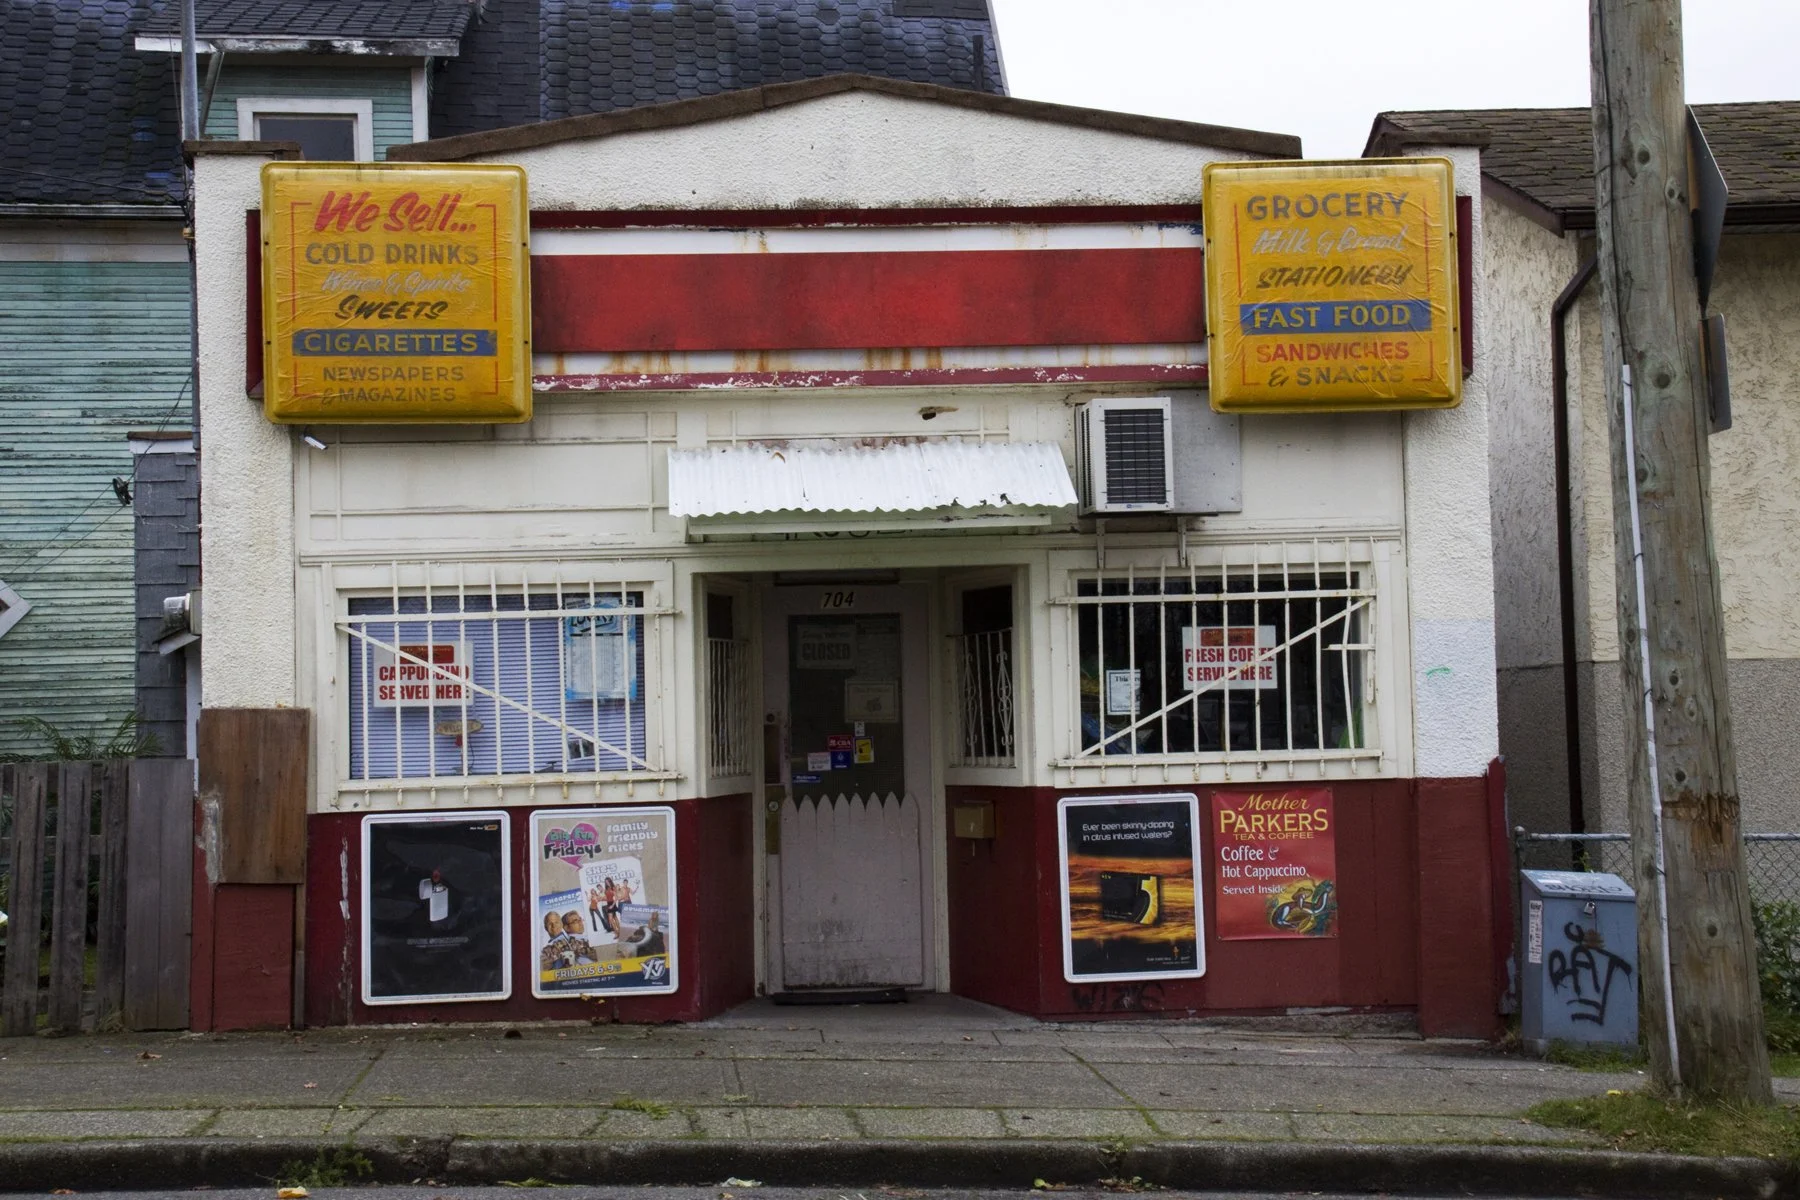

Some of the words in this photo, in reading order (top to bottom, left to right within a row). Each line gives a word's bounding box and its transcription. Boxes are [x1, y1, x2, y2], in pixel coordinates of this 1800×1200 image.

[314, 191, 380, 233] We
[383, 191, 477, 233] Sell...
[1247, 191, 1409, 221] GROCERY
[1252, 227, 1312, 255] Milk
[1316, 230, 1335, 258] &
[1336, 224, 1408, 254] Bread
[305, 242, 374, 265] COLD
[385, 243, 479, 265] DRINKS
[321, 268, 384, 292] Wines
[384, 272, 402, 297] &
[404, 270, 472, 298] Spirits
[1256, 263, 1413, 289] STATIONERY
[334, 294, 449, 320] SWEETS
[1253, 306, 1321, 329] FAST
[1333, 303, 1411, 327] FOOD
[303, 332, 478, 353] CIGARETTES
[1256, 340, 1410, 363] SANDWICHES
[322, 365, 465, 382] NEWSPAPERS
[1267, 366, 1289, 388] &
[1296, 364, 1406, 387] SNACKS
[321, 388, 334, 405] &
[339, 387, 457, 402] MAGAZINES
[823, 591, 855, 608] 704
[802, 643, 851, 660] CLOSED
[1229, 647, 1275, 662] COFEE
[1238, 793, 1311, 811] Mother
[1082, 823, 1100, 831] Ever
[1101, 822, 1121, 831] been
[1121, 821, 1174, 830] skinny-dipping
[1220, 808, 1329, 833] PARKERS
[1091, 833, 1111, 841] citrus
[1112, 832, 1140, 840] infused
[1140, 831, 1173, 840] waters?
[1232, 833, 1255, 841] TEA
[1268, 832, 1315, 840] COFFEE
[544, 840, 602, 860] Fridays
[1221, 845, 1264, 861] Coffee
[1268, 845, 1279, 861] &
[1222, 865, 1241, 878] Hot
[1244, 864, 1306, 880] Cappuccino
[1223, 885, 1255, 894] Served
[555, 966, 595, 979] FRIDAYS
